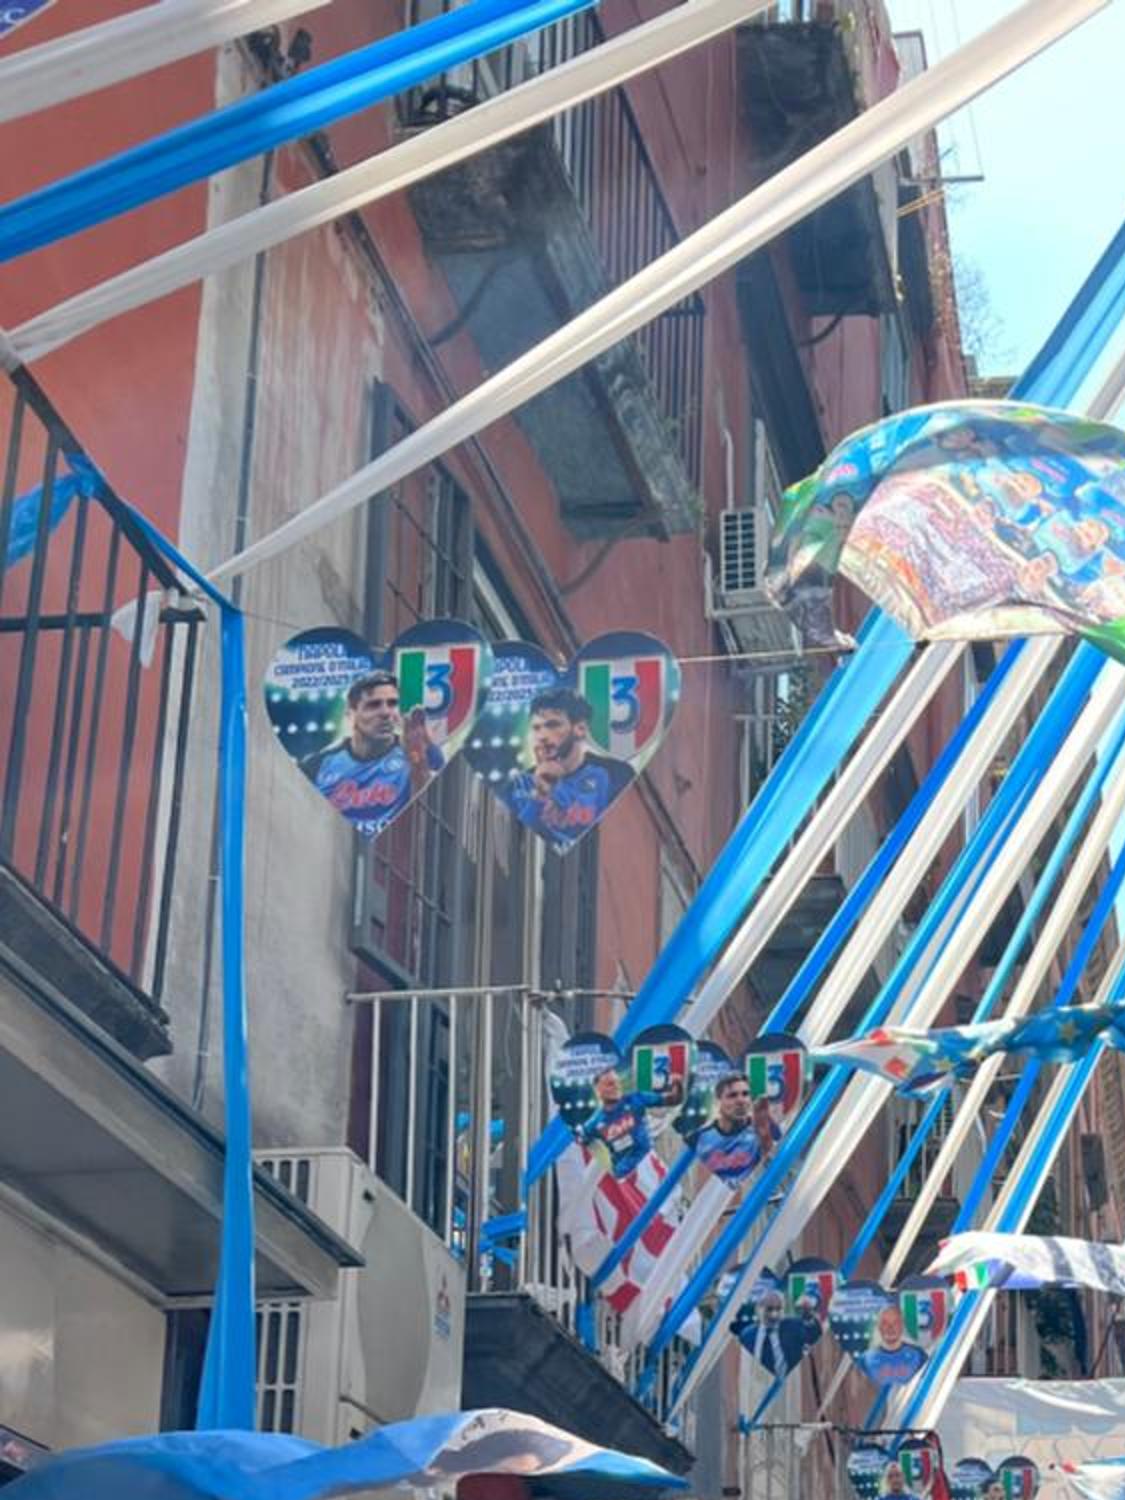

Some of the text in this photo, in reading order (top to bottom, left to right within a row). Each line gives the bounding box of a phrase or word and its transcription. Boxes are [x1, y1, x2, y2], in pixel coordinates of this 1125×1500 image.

[426, 663, 453, 716] 3
[611, 676, 640, 734] 3
[767, 1064, 785, 1104] 3
[917, 1300, 933, 1330] 3
